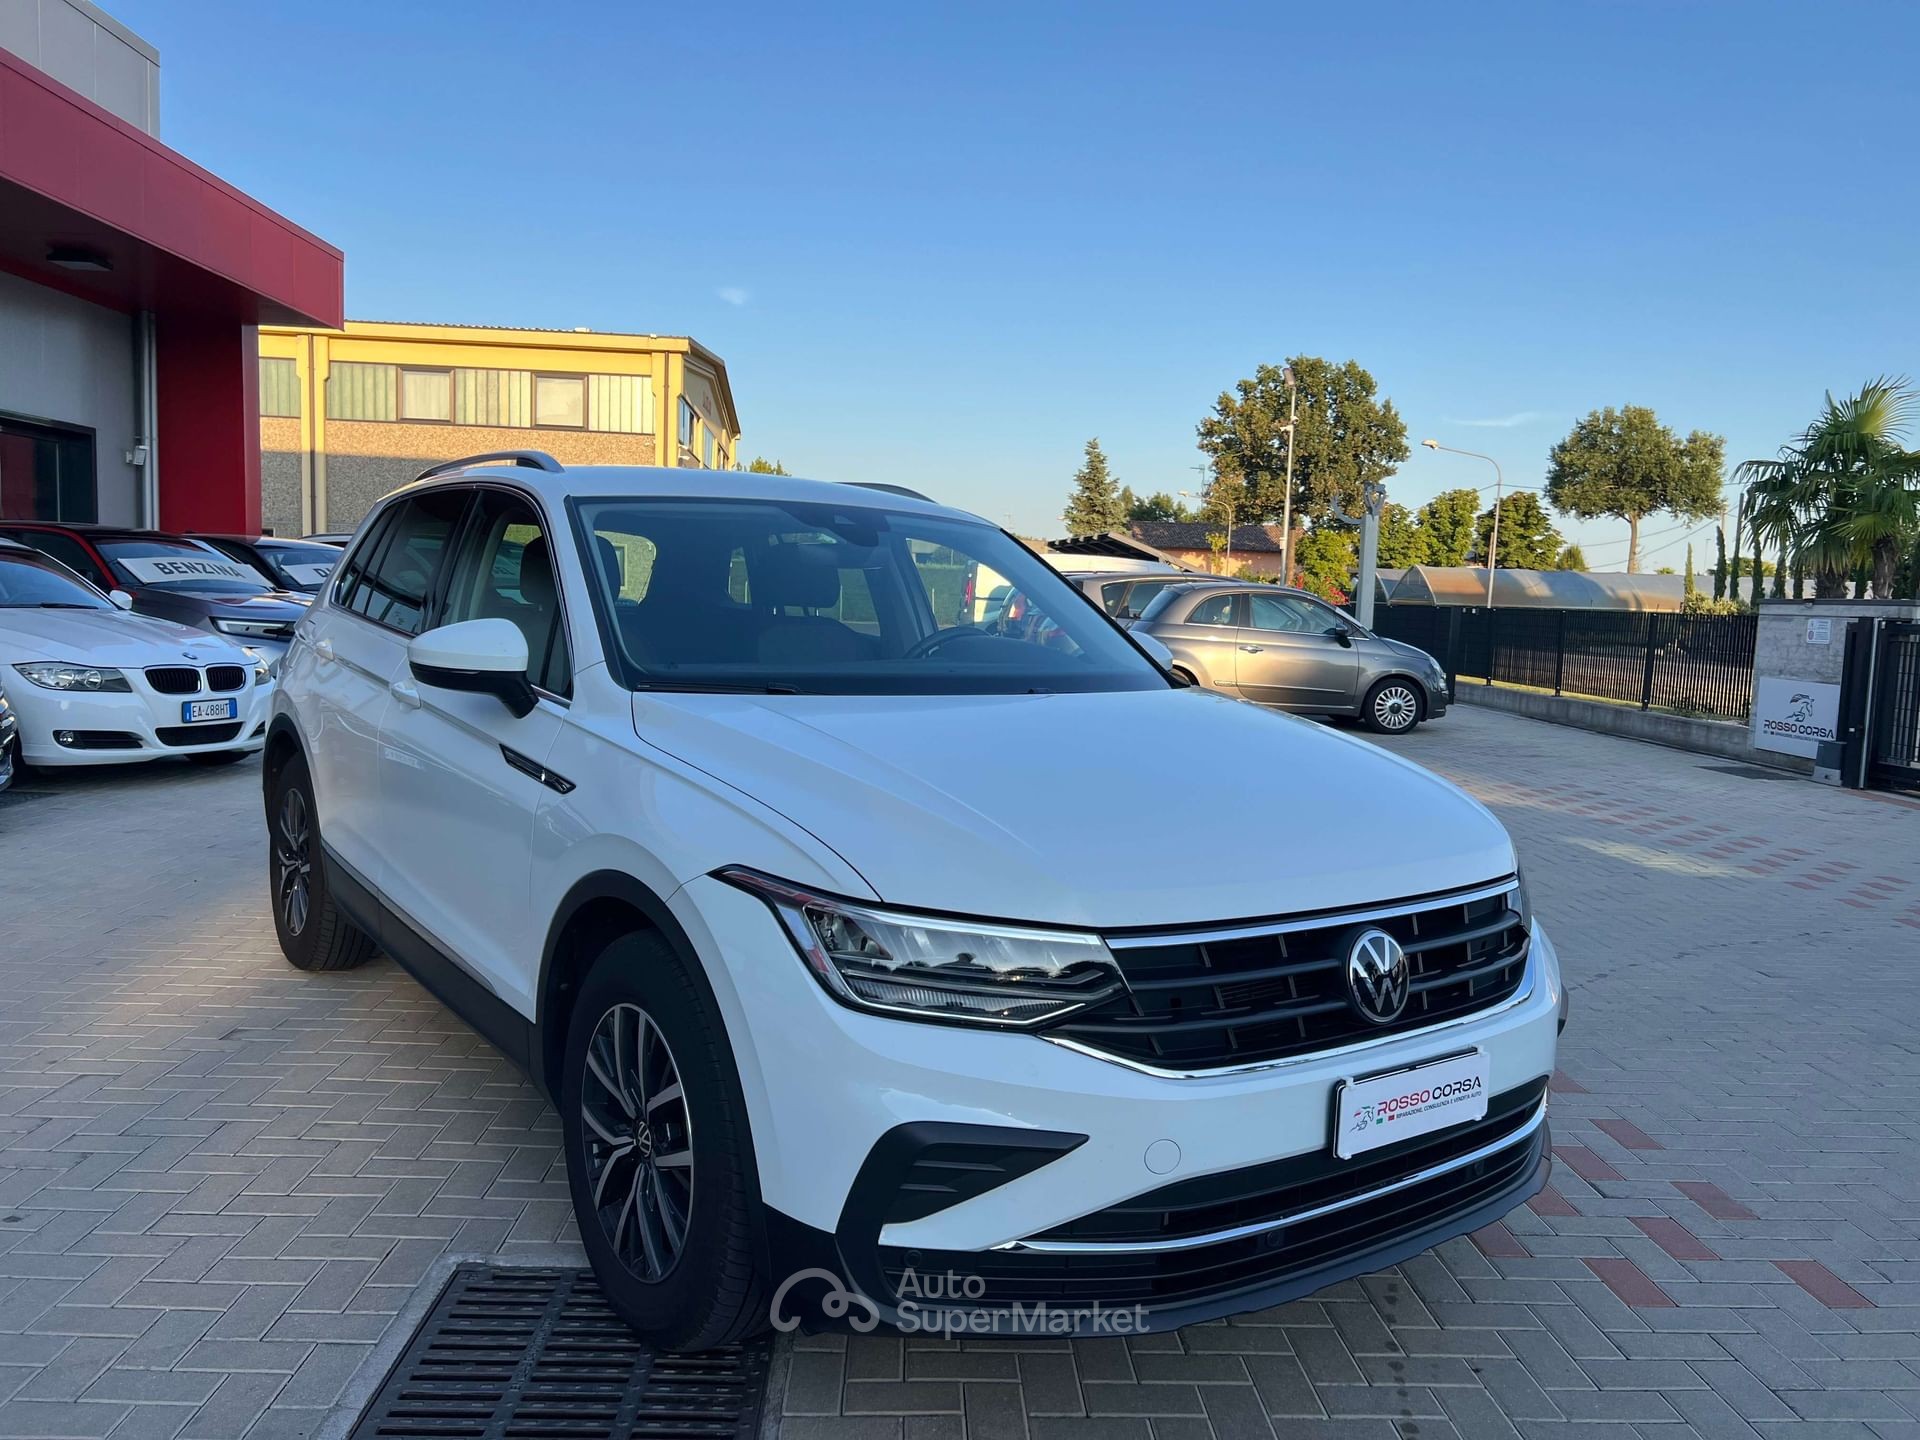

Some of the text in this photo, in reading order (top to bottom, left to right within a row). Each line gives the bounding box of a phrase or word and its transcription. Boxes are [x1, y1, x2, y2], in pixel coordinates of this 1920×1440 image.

[152, 562, 246, 579] BENZINA
[1763, 719, 1798, 734] ROSSO
[1798, 724, 1835, 739] CORSA
[1377, 1076, 1482, 1116] ROSSO CORSA
